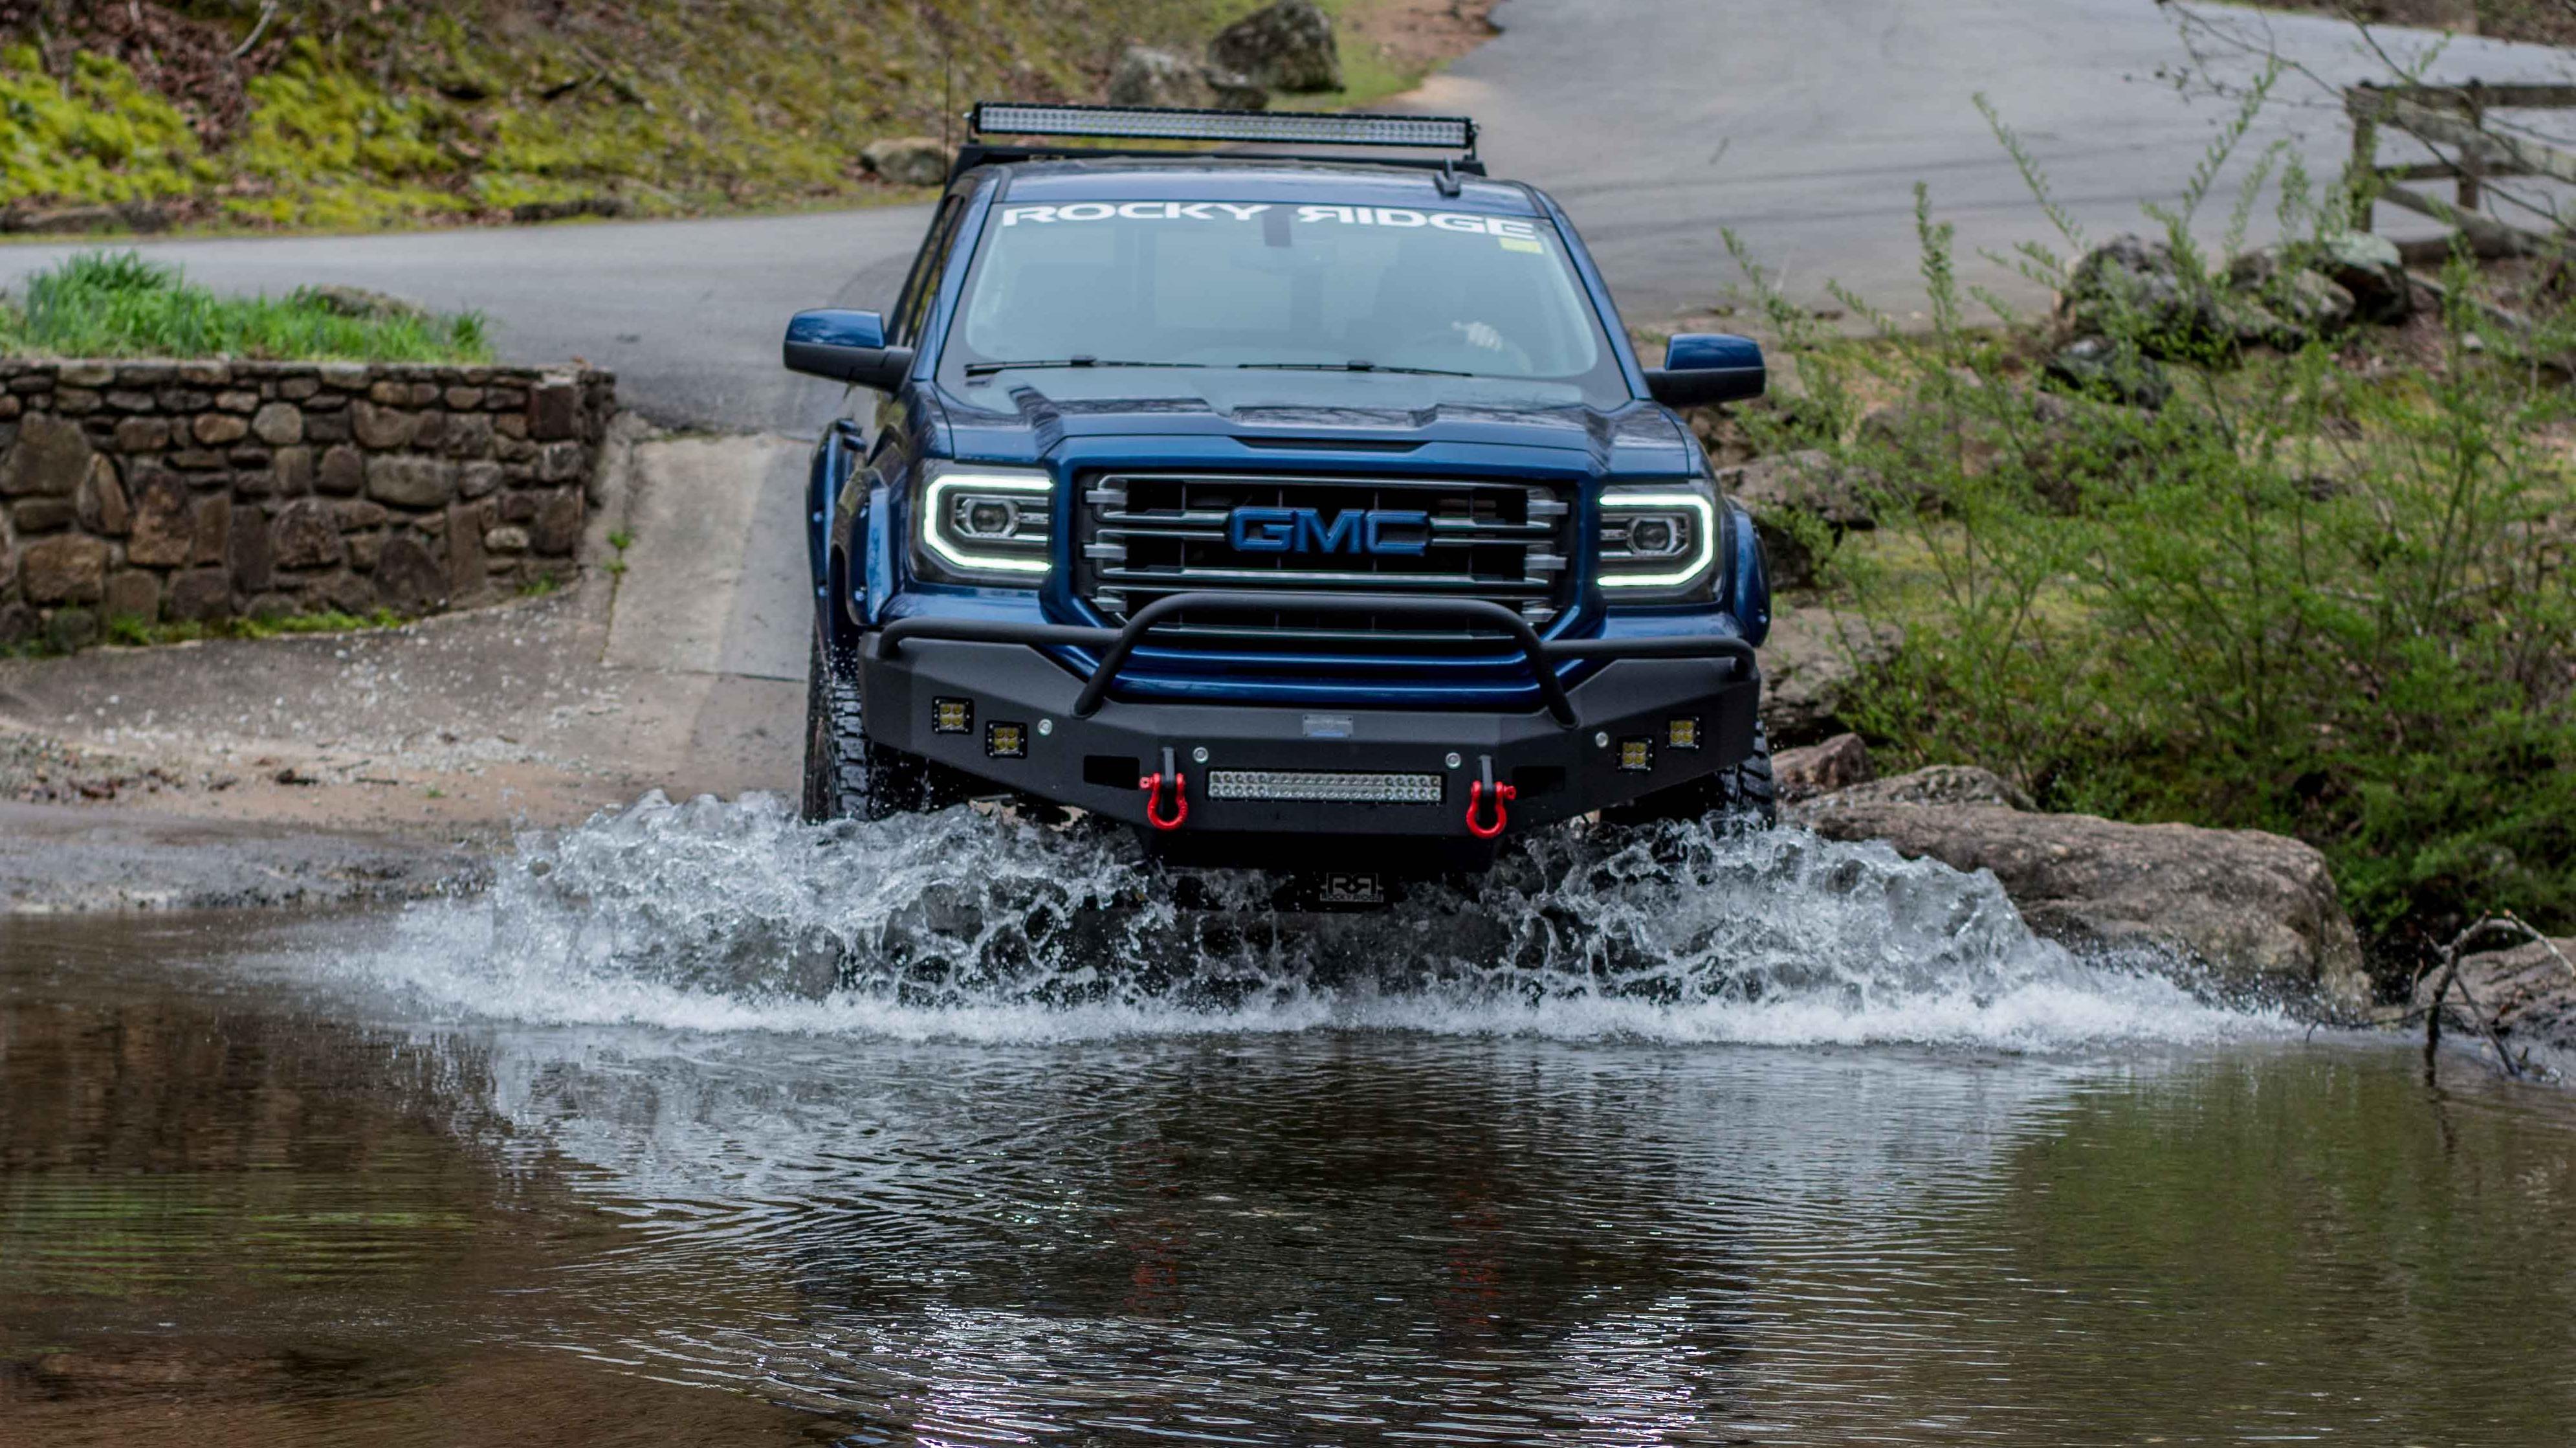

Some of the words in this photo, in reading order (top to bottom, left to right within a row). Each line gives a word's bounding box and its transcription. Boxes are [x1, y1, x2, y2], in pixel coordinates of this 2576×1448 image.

[1002, 202, 1273, 227] ROCKY
[1297, 205, 1537, 240] RIDGE
[1230, 505, 1428, 556] GMC
